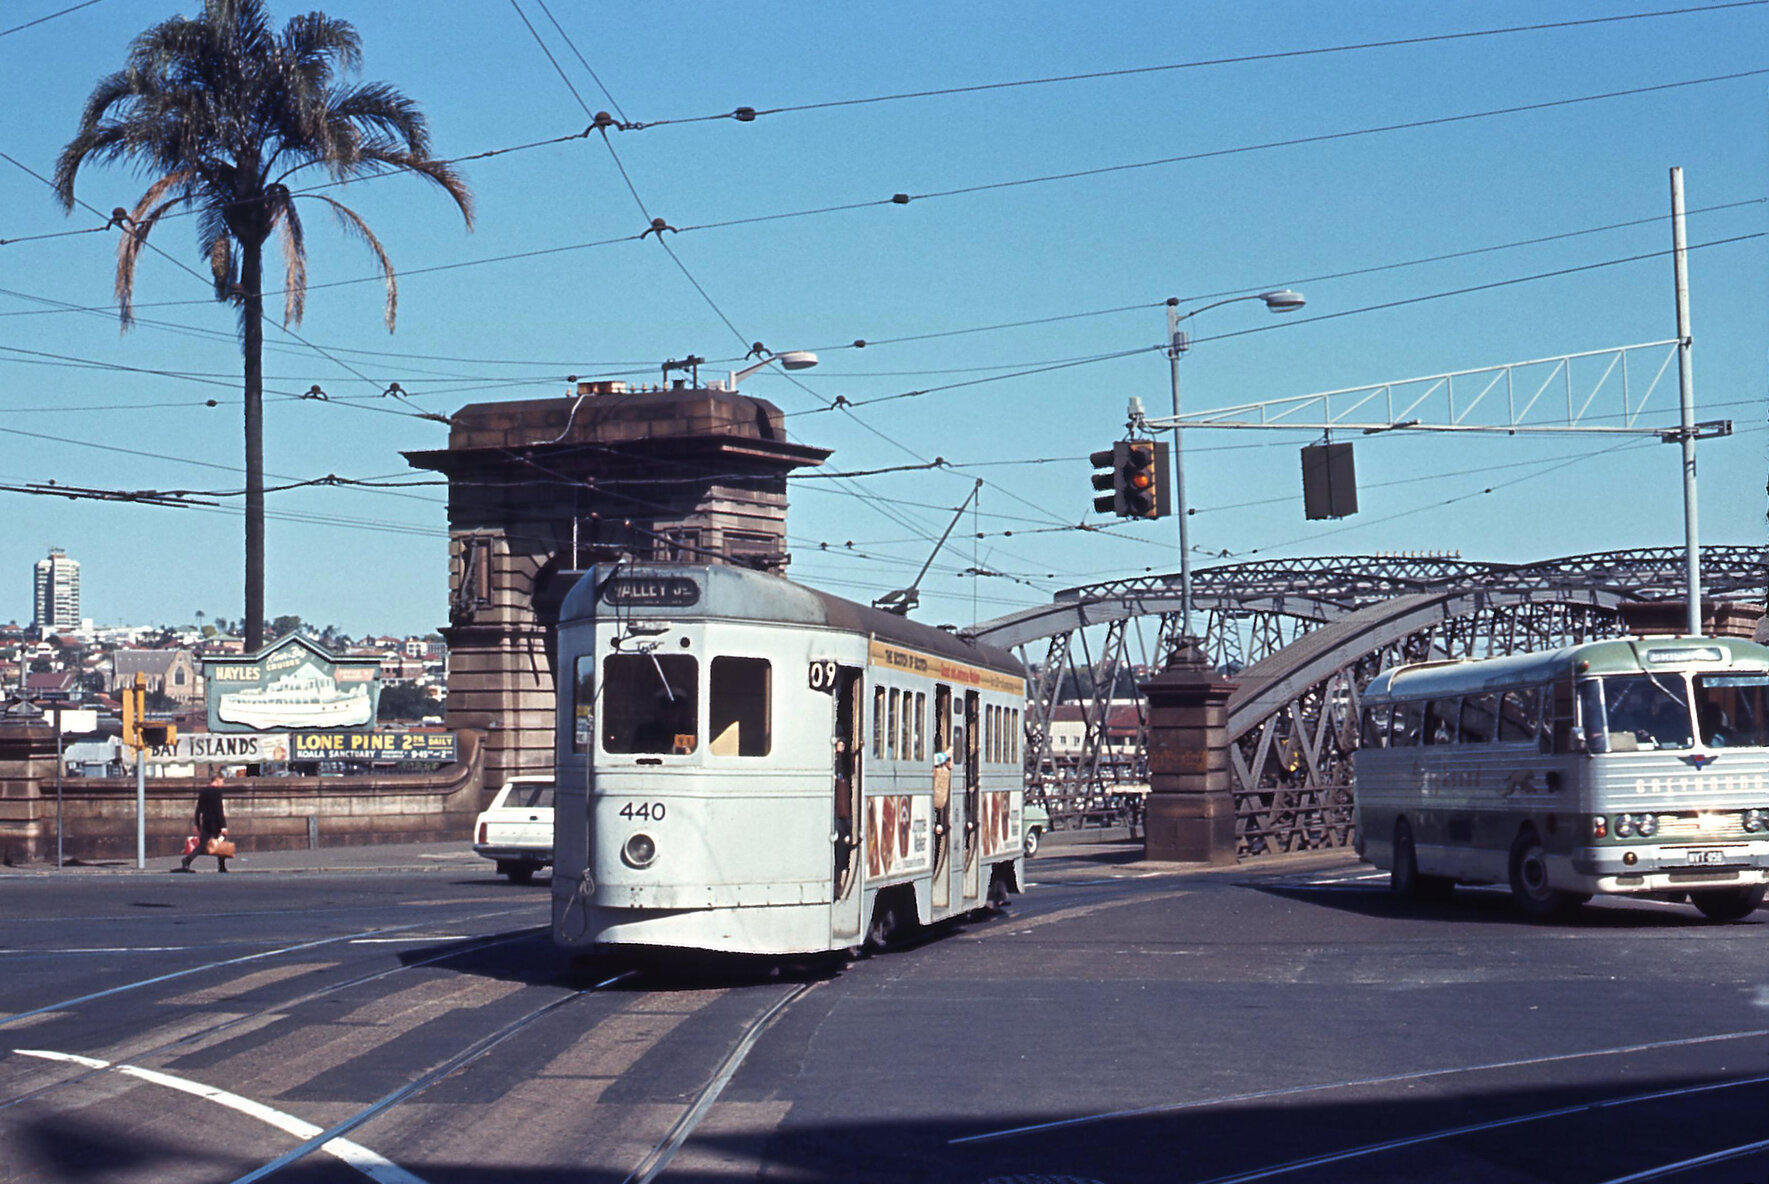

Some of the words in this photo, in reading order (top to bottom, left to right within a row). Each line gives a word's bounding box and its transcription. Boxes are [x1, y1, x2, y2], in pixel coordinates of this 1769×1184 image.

[215, 666, 261, 681] HAYLES
[811, 662, 836, 688] 09
[190, 736, 258, 757] ISLANDS
[296, 735, 344, 750] LONE
[351, 735, 395, 750] PINE
[428, 736, 453, 746] DAILY
[297, 750, 326, 758] KOALA
[328, 750, 376, 759] SANCTUARY
[1635, 774, 1763, 795] GREYHOUND
[619, 802, 666, 821] 440
